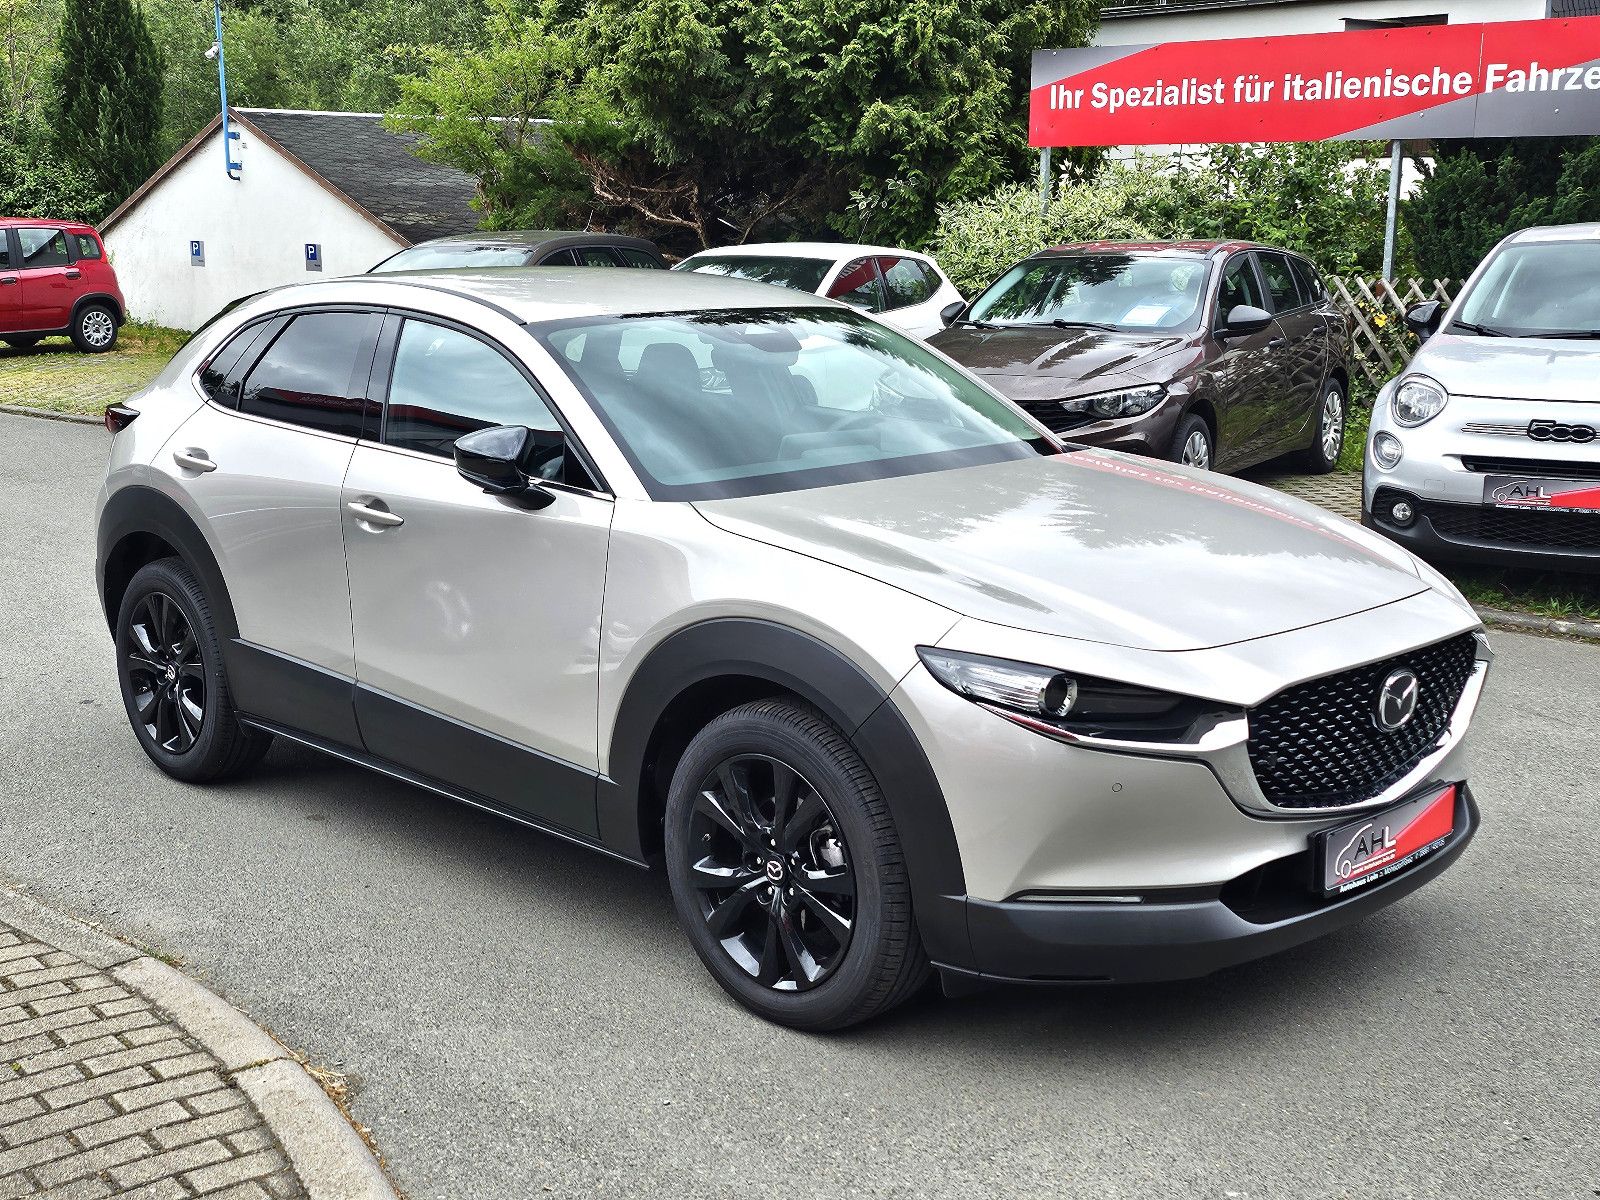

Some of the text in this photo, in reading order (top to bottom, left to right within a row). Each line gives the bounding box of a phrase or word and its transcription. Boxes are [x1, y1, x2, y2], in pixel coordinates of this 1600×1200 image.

[1050, 62, 1600, 114] Ihr Spezialist für italienische Fahrze
[192, 242, 199, 254] P
[308, 245, 315, 258] P
[1527, 419, 1596, 443] 500
[1510, 485, 1551, 498] AHL
[1354, 826, 1397, 860] AHL
